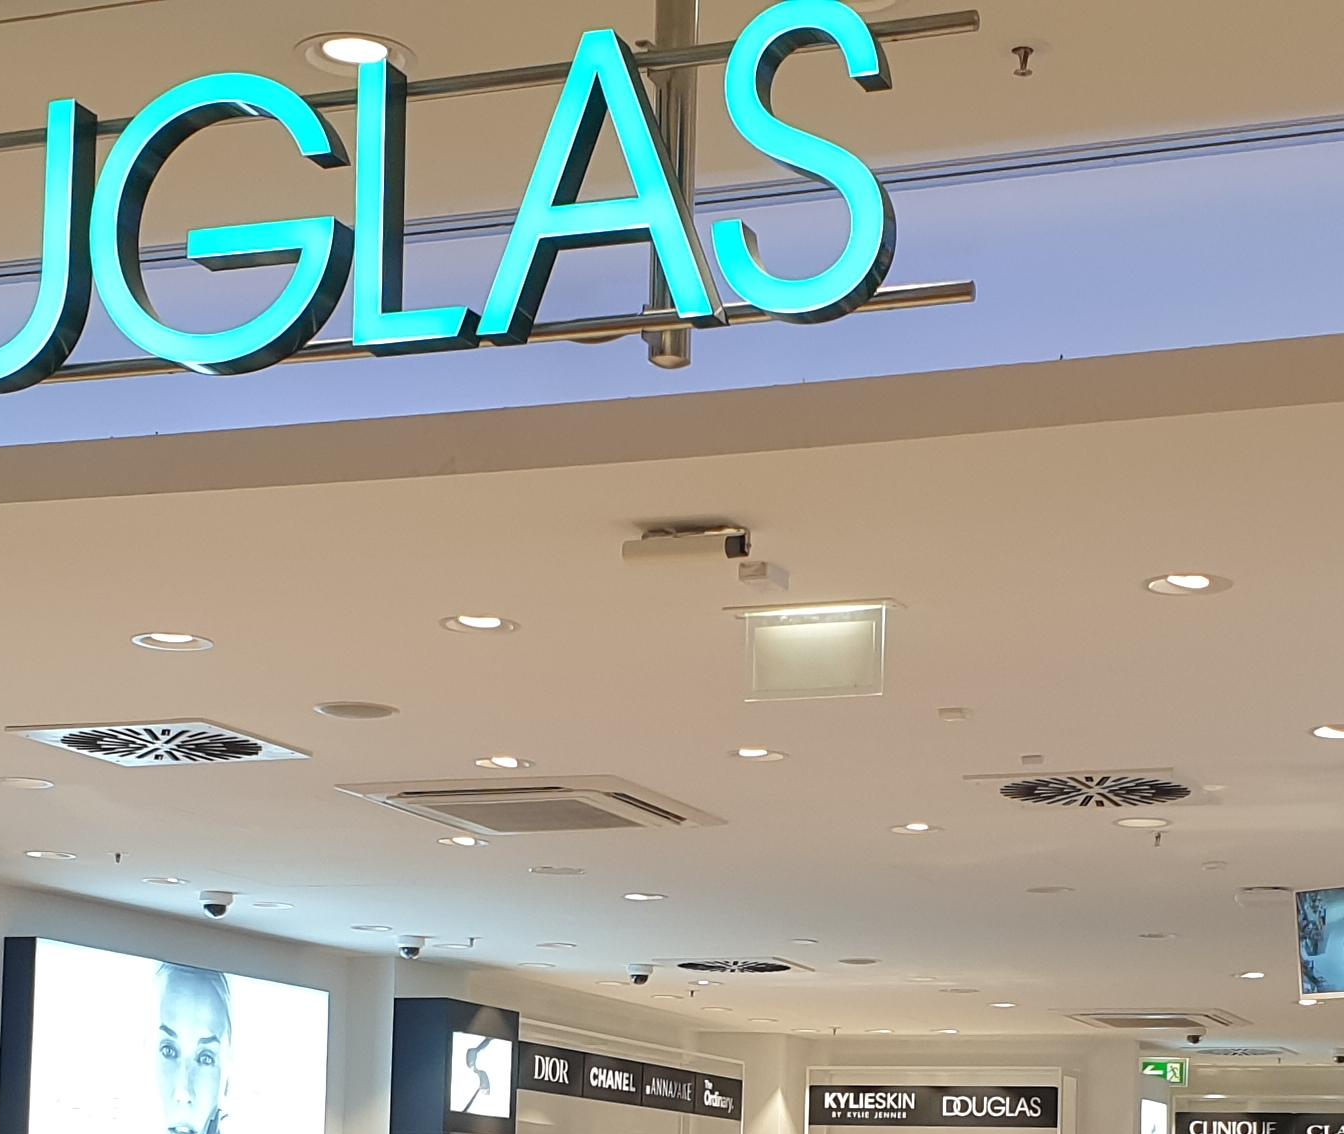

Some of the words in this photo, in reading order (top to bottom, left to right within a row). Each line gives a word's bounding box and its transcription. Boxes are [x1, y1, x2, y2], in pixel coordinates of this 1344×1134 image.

[534, 1055, 570, 1084] DIOR
[590, 1066, 636, 1093] CHANEL
[651, 1077, 692, 1102] ANNAYAKE
[704, 1079, 714, 1091] The
[824, 1092, 916, 1110] KYLIESKIN
[942, 1095, 1042, 1118] DOUGLAS
[847, 1111, 870, 1119] KYLIE
